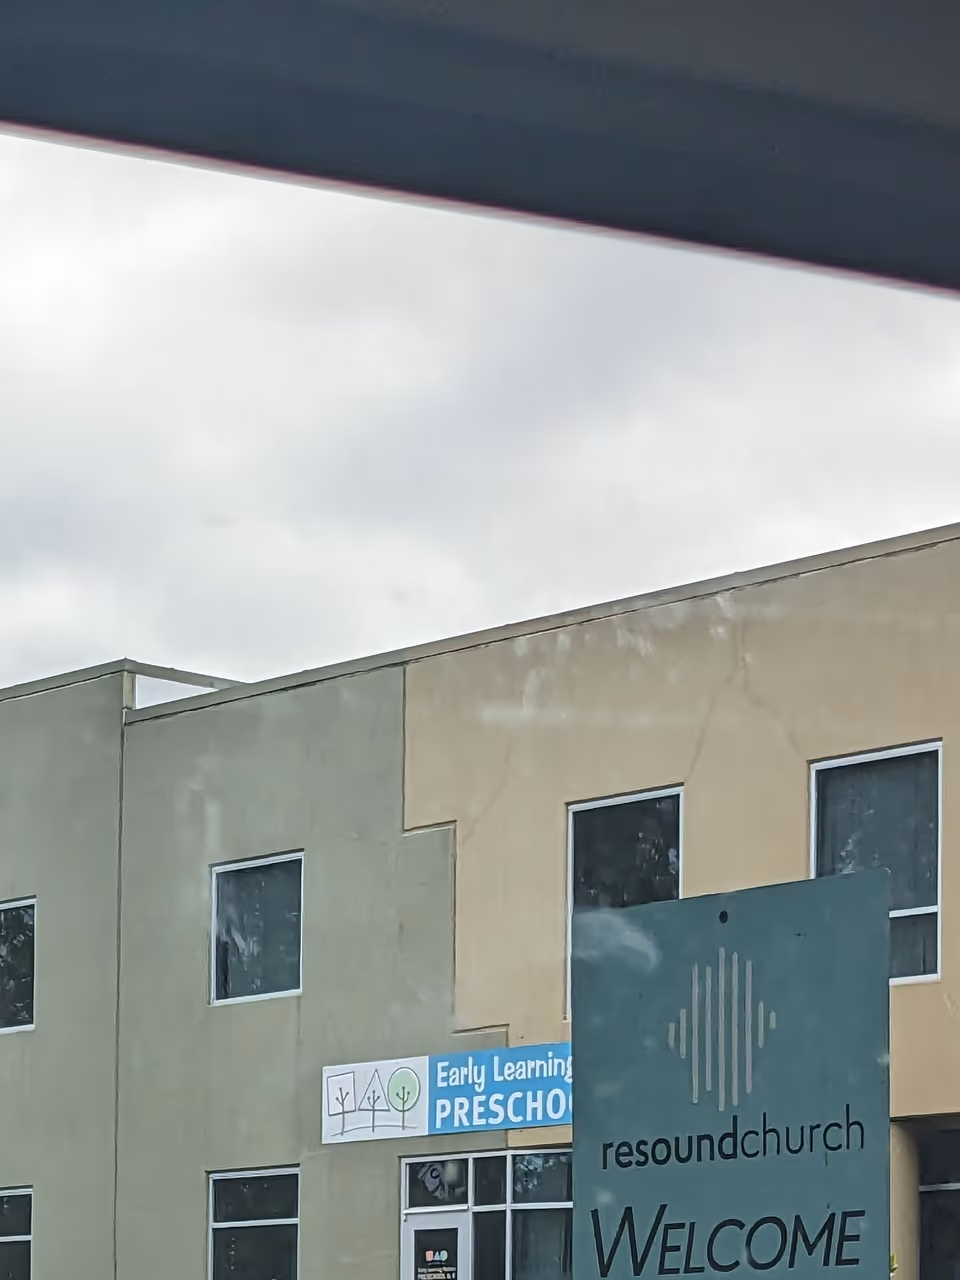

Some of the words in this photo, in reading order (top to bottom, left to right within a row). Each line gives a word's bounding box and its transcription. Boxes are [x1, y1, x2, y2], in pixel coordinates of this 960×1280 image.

[436, 1061, 486, 1093] Early
[493, 1051, 573, 1085] Learning
[435, 1088, 573, 1129] PRESCHO
[601, 1103, 865, 1170] resoundchurch
[590, 1203, 866, 1278] WELCOME
